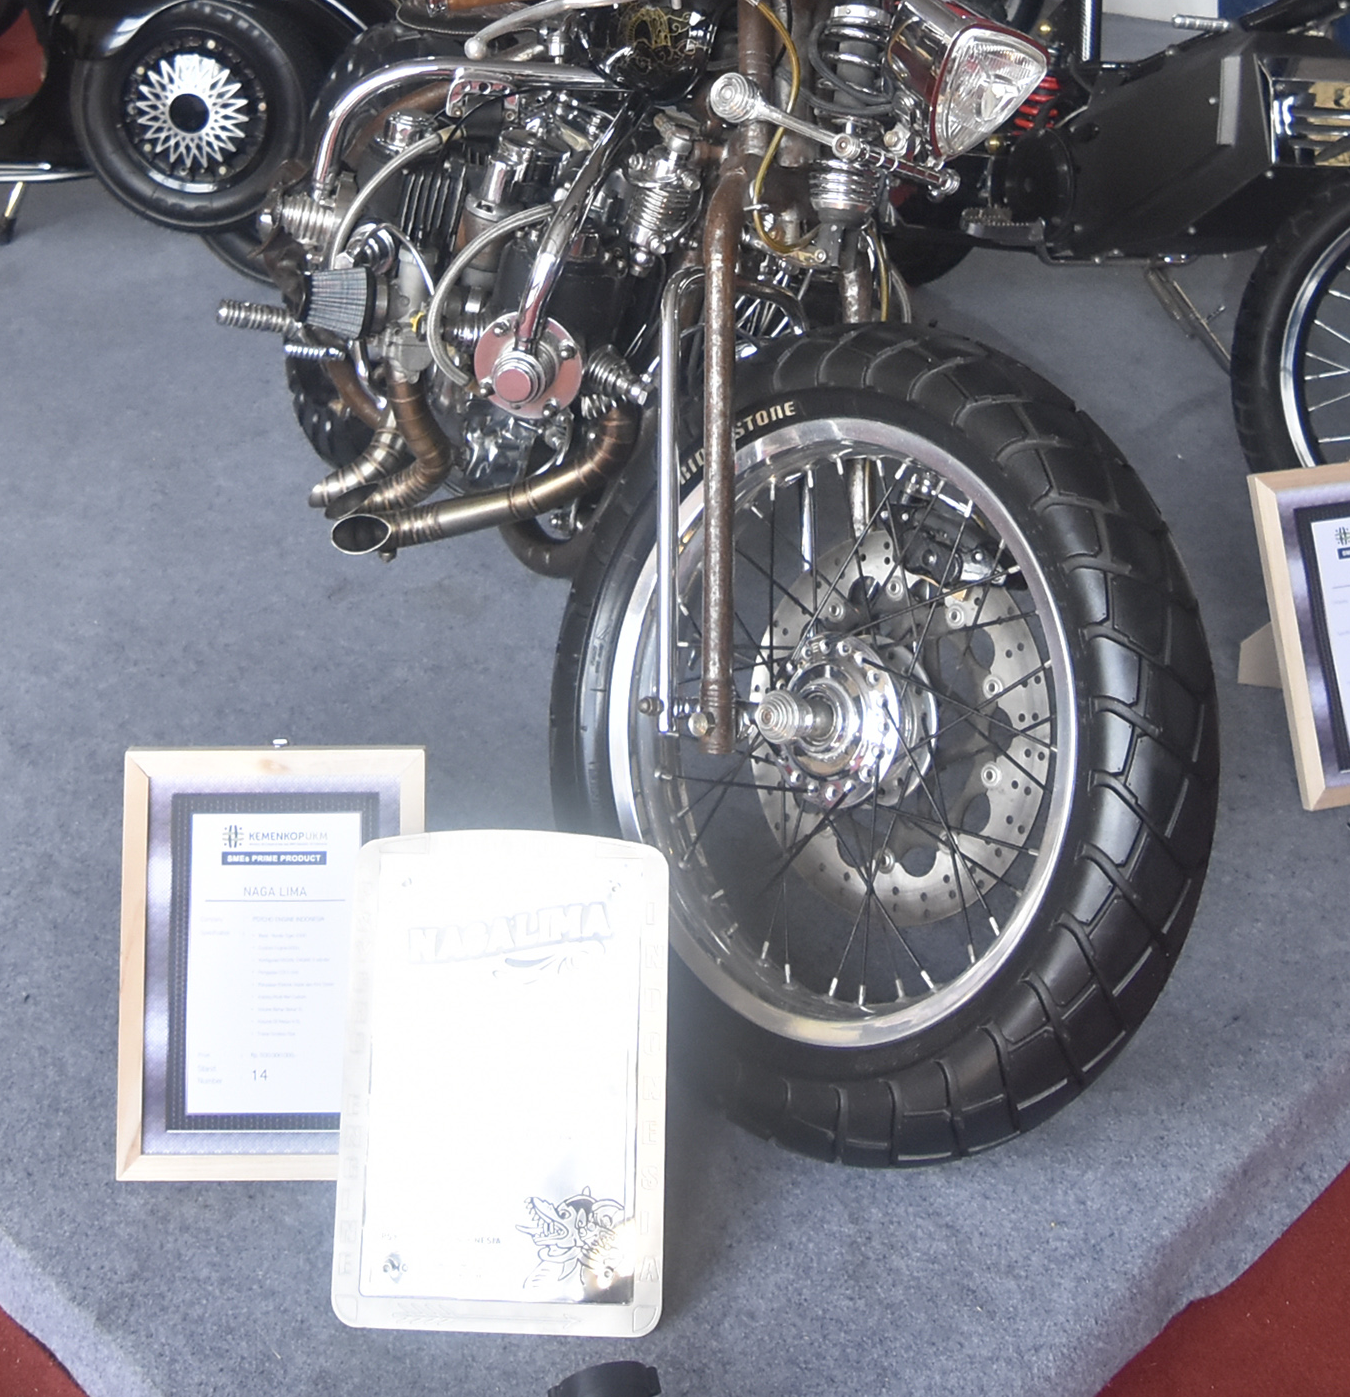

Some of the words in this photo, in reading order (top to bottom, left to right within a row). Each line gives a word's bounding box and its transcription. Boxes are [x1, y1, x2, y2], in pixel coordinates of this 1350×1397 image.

[248, 831, 329, 842] KEMENKOPUKM
[227, 854, 250, 863] SMEs
[251, 854, 279, 863] PRIME
[279, 853, 322, 863] PRODUCT
[243, 886, 276, 898] NAGA
[279, 886, 308, 898] LIMA
[252, 1069, 269, 1081] 14
